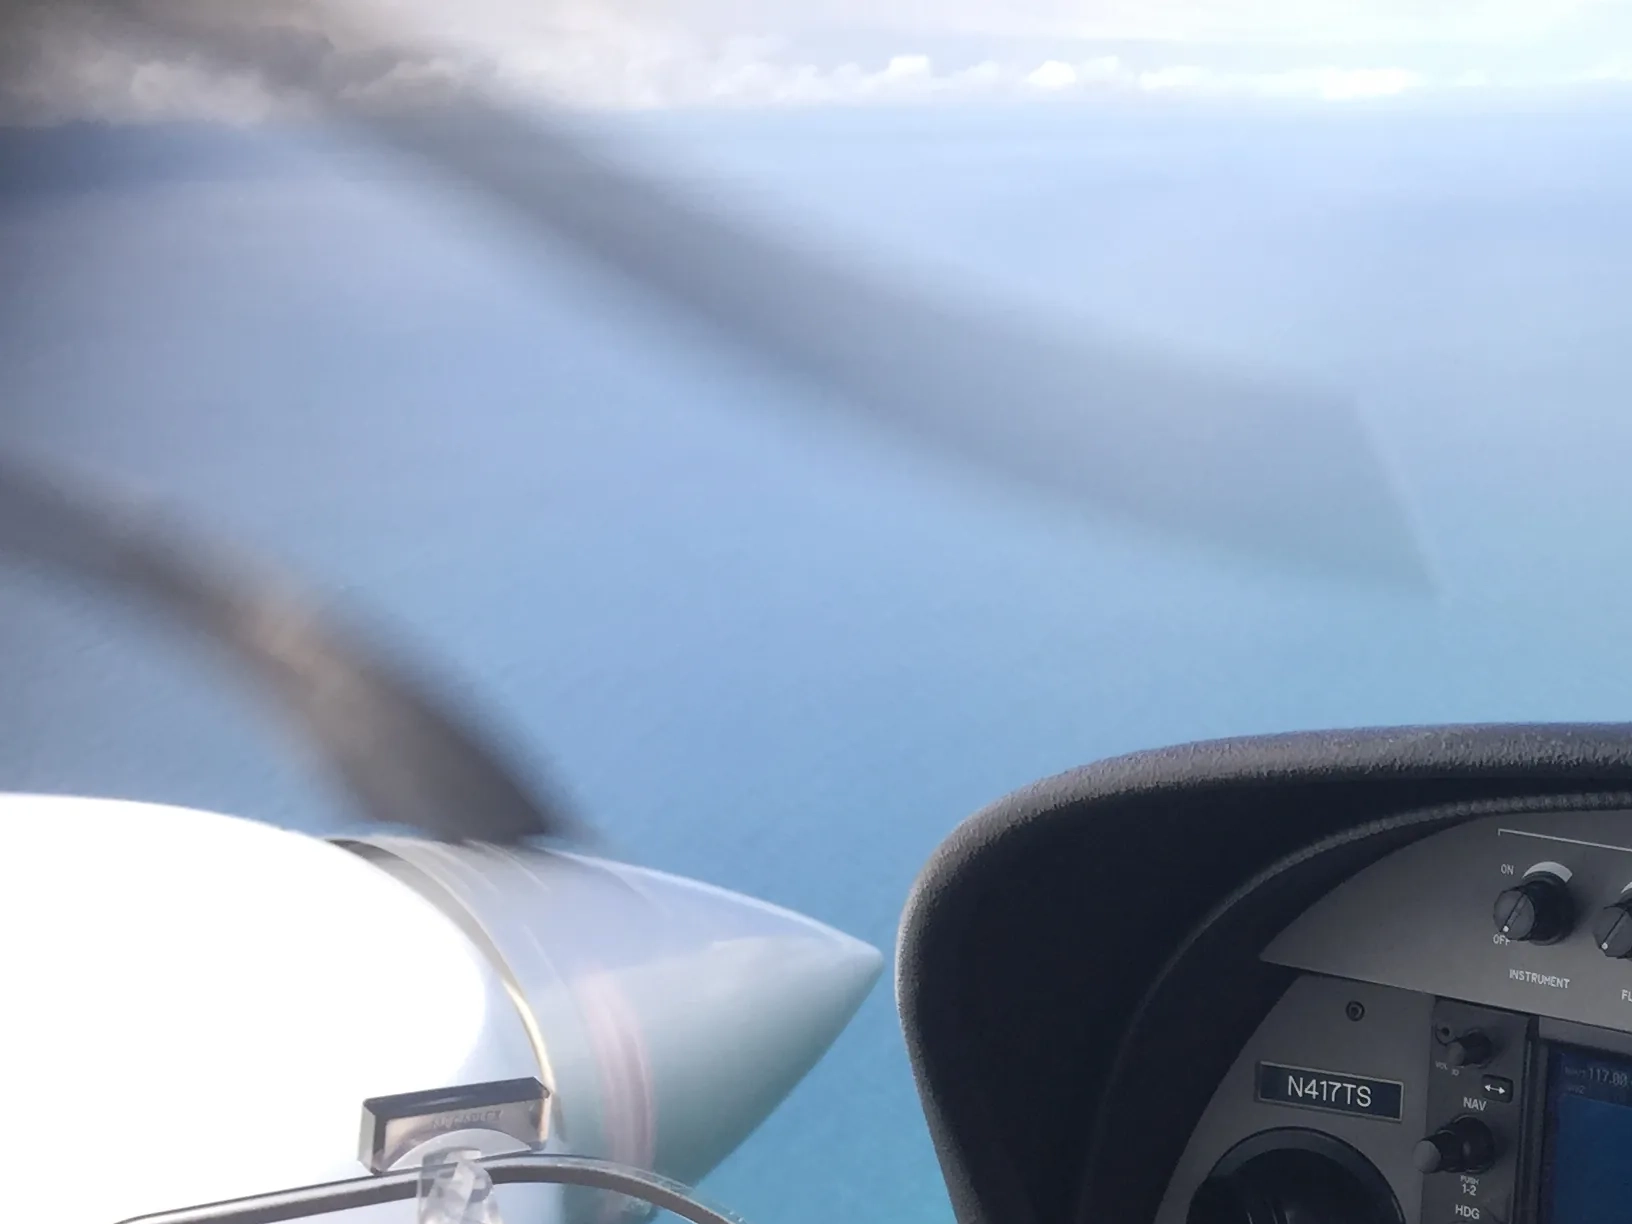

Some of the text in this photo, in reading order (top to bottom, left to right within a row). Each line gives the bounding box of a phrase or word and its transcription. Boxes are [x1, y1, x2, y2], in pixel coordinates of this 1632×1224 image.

[1508, 970, 1571, 989] INSTRUMENT
[1287, 1075, 1372, 1108] N417TS
[1455, 1203, 1480, 1220] HDG
